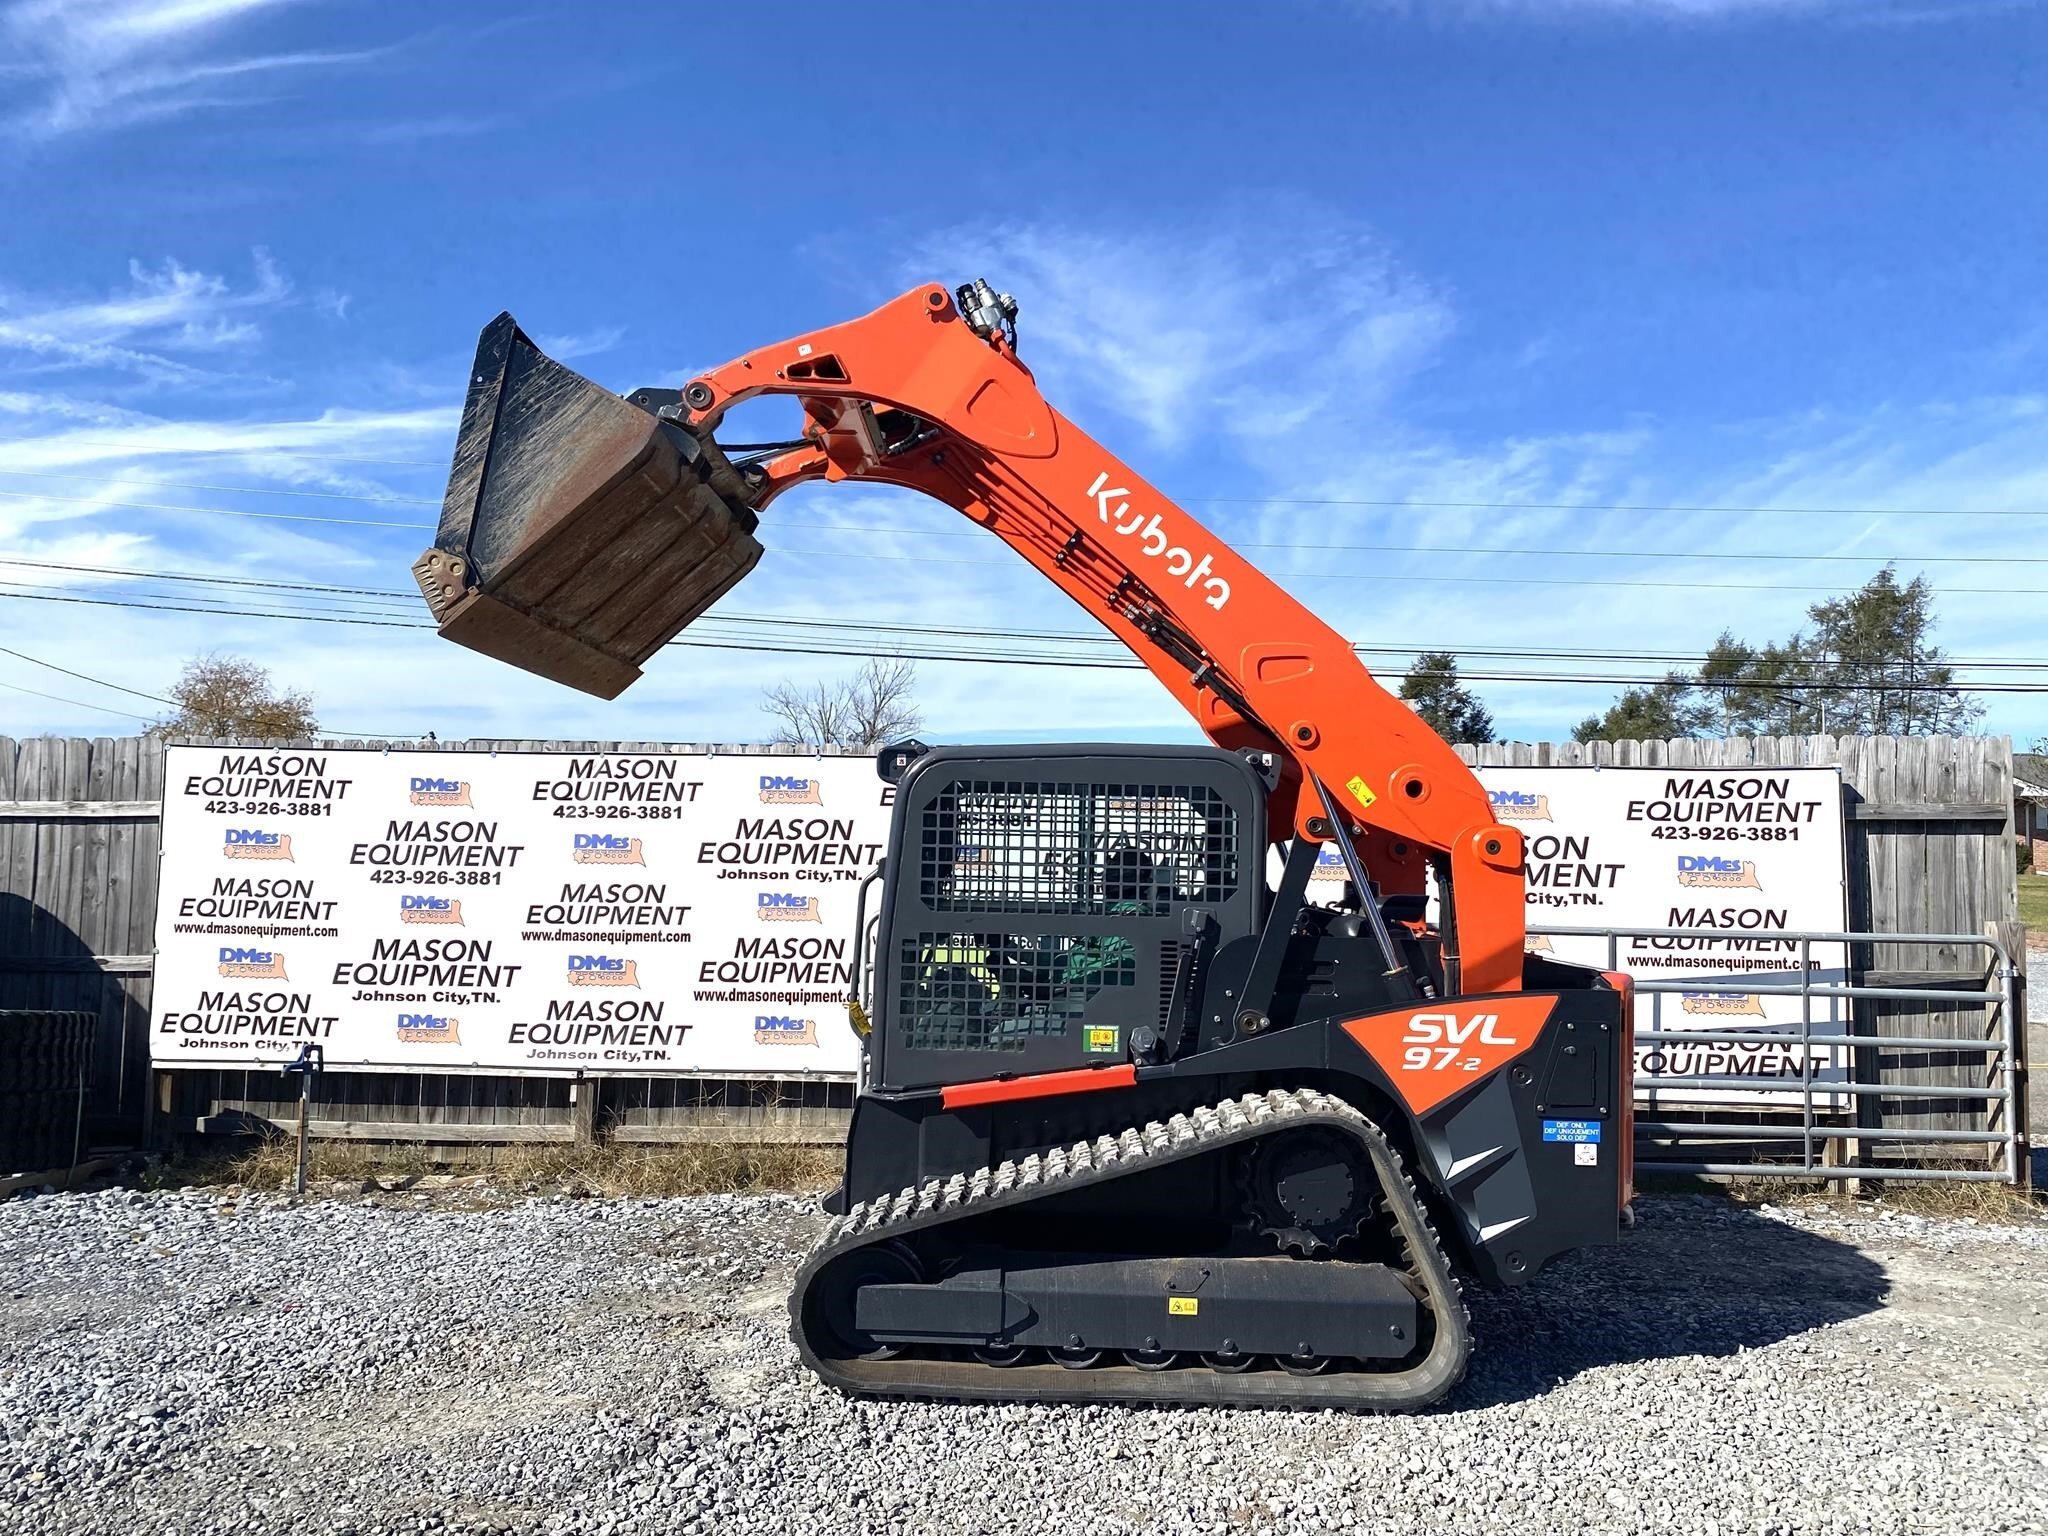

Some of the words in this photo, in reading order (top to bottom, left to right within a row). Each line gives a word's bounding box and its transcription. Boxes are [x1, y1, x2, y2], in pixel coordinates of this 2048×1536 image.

[1086, 471, 1231, 611] Kubota
[219, 756, 326, 776] MASON
[568, 759, 676, 779] MASON
[184, 777, 352, 799] EQUIPMENT
[533, 781, 703, 801] EQUIPMENT
[1664, 778, 1789, 800] MASON
[205, 801, 331, 816] 423-926-3881
[553, 805, 681, 819] 423-926-3881
[1626, 801, 1822, 824] EQUIPMENT
[386, 821, 497, 842] MASON
[736, 819, 854, 840] MASON
[1651, 827, 1799, 841] 423-926-3881
[350, 844, 524, 867] EQUIPMENT
[698, 842, 883, 866] EQUIPMENT
[370, 870, 500, 885] 423-926-3881
[717, 869, 789, 879] Johnson
[213, 878, 314, 898] MASON
[560, 884, 666, 903] MASON
[179, 898, 338, 920] EQUIPMENT
[526, 905, 691, 925] EQUIPMENT
[1668, 908, 1788, 929] MASON
[174, 922, 338, 938] www.dmasonequipment.com
[522, 929, 690, 945] www.dmasonequipment.com
[372, 939, 492, 962] MASON
[734, 938, 845, 959] MASON
[333, 963, 521, 987] EQUIPMENT
[699, 962, 852, 983] EQUIPMEN
[198, 992, 311, 1013] MASON
[352, 991, 426, 1001] Johnson
[546, 1000, 664, 1021] MASON
[160, 1013, 339, 1037] EQUIPMENT
[509, 1024, 693, 1045] EQUIPMENT
[1402, 1013, 1517, 1045] SVL
[179, 1038, 248, 1048] Johnson
[527, 1049, 597, 1059] Johnson
[1402, 1046, 1482, 1071] 97-2
